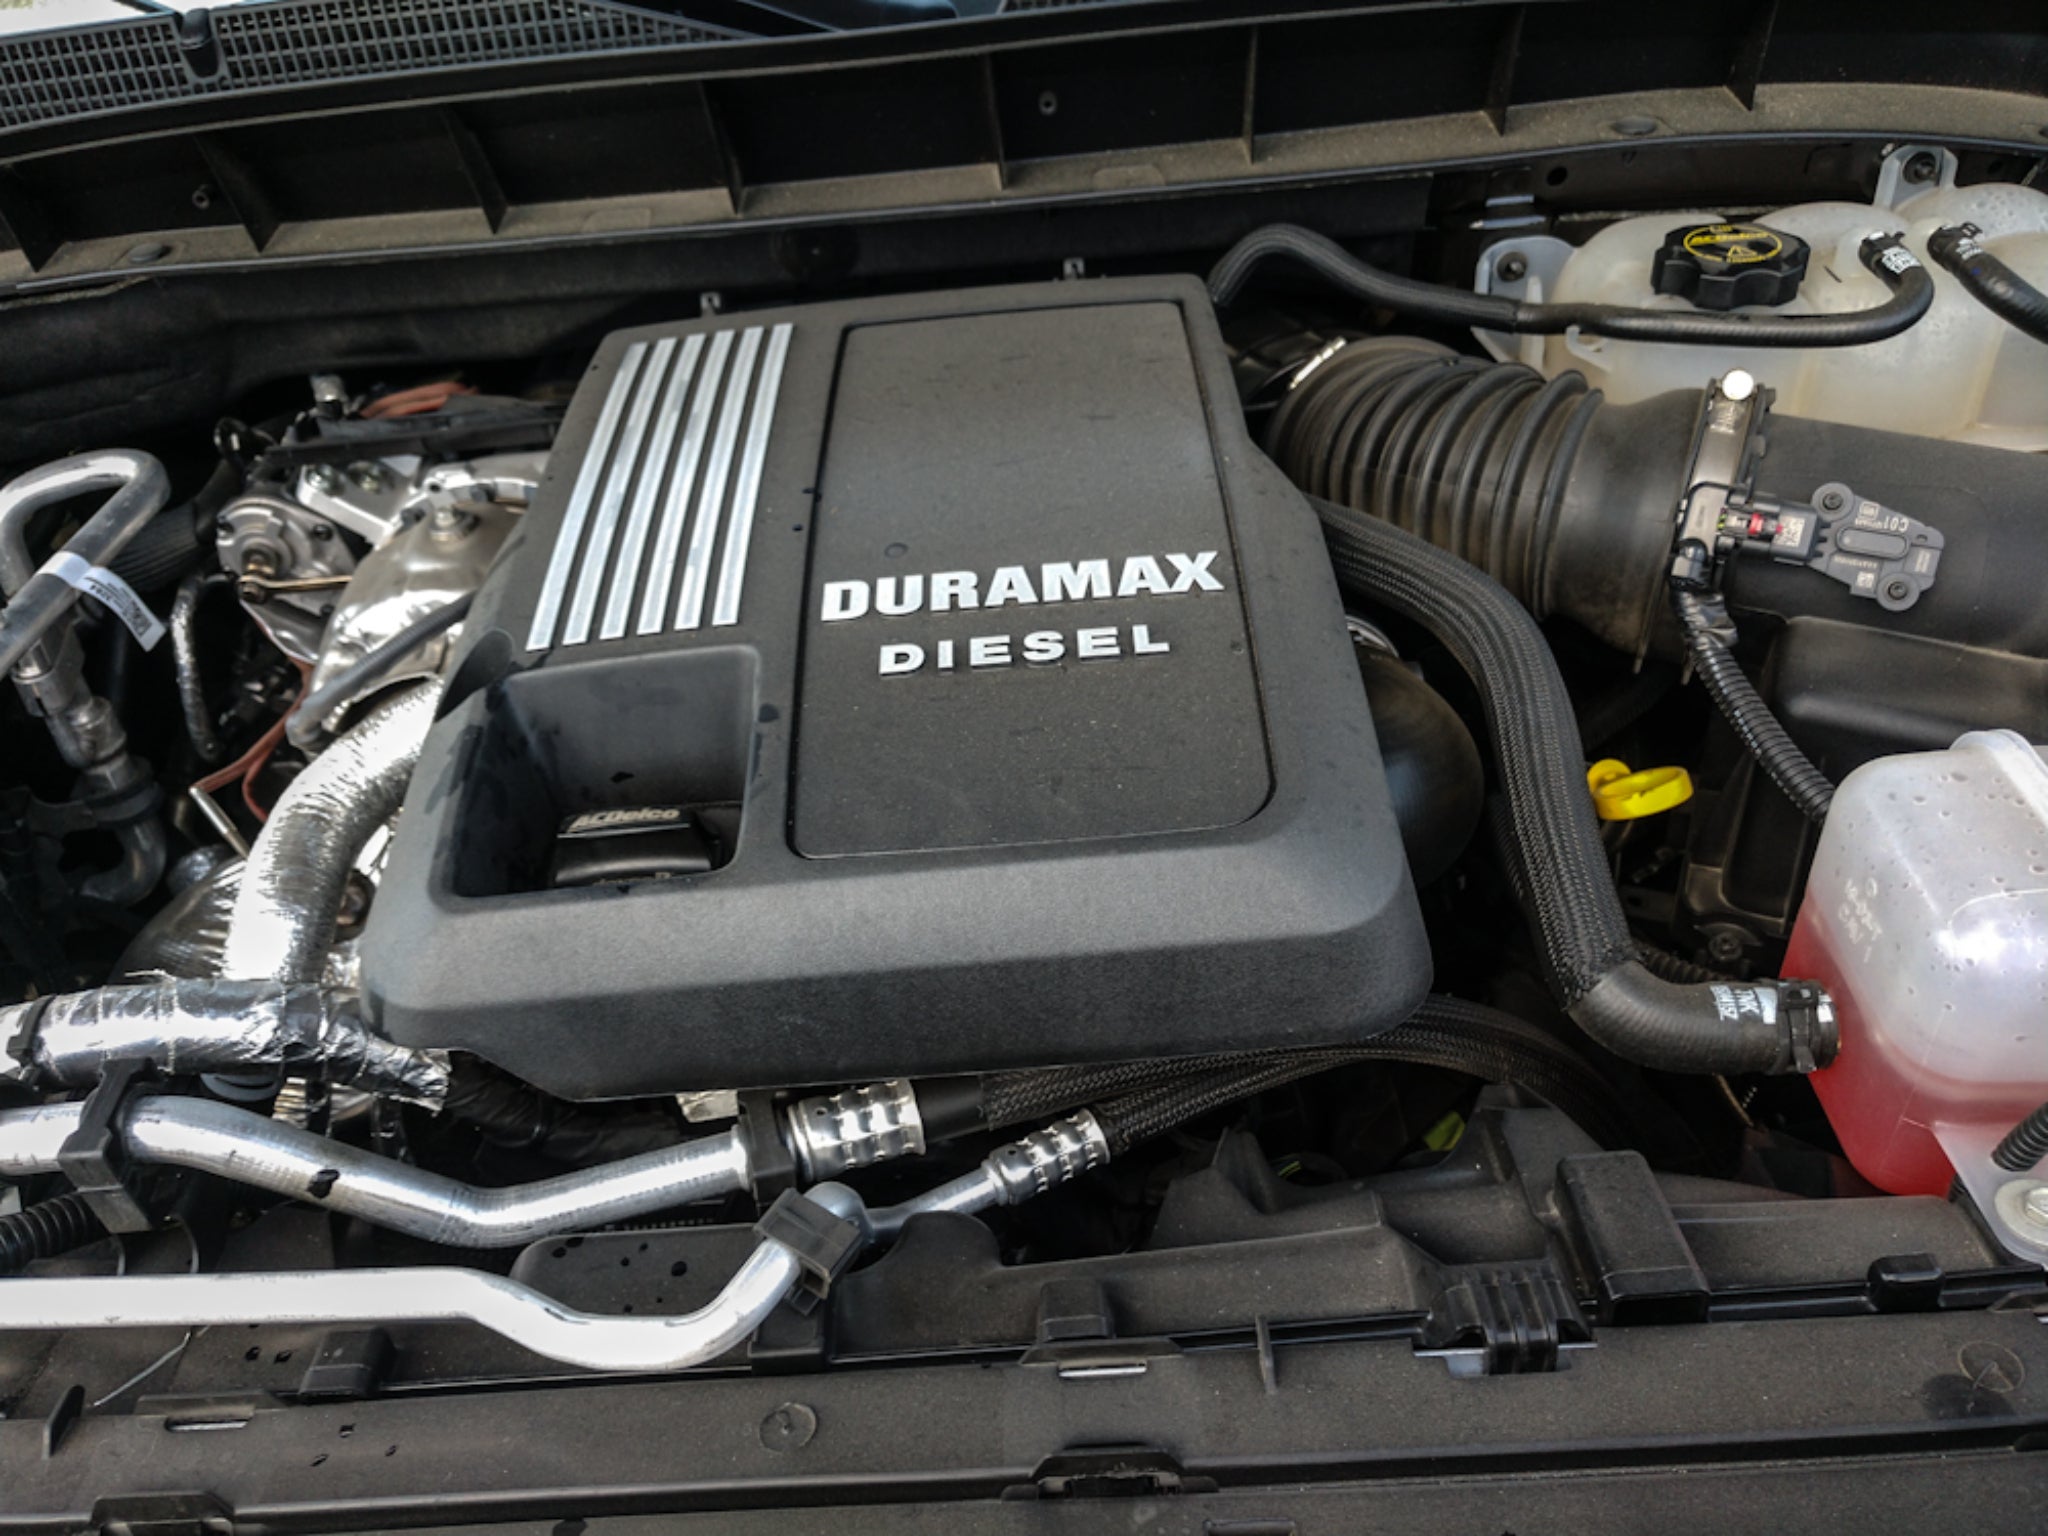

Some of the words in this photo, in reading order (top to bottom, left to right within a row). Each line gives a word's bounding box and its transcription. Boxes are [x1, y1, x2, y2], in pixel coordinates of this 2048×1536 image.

[821, 551, 1225, 621] DURAMAX
[878, 624, 1170, 675] DIESEL
[567, 808, 680, 833] ACDelco
